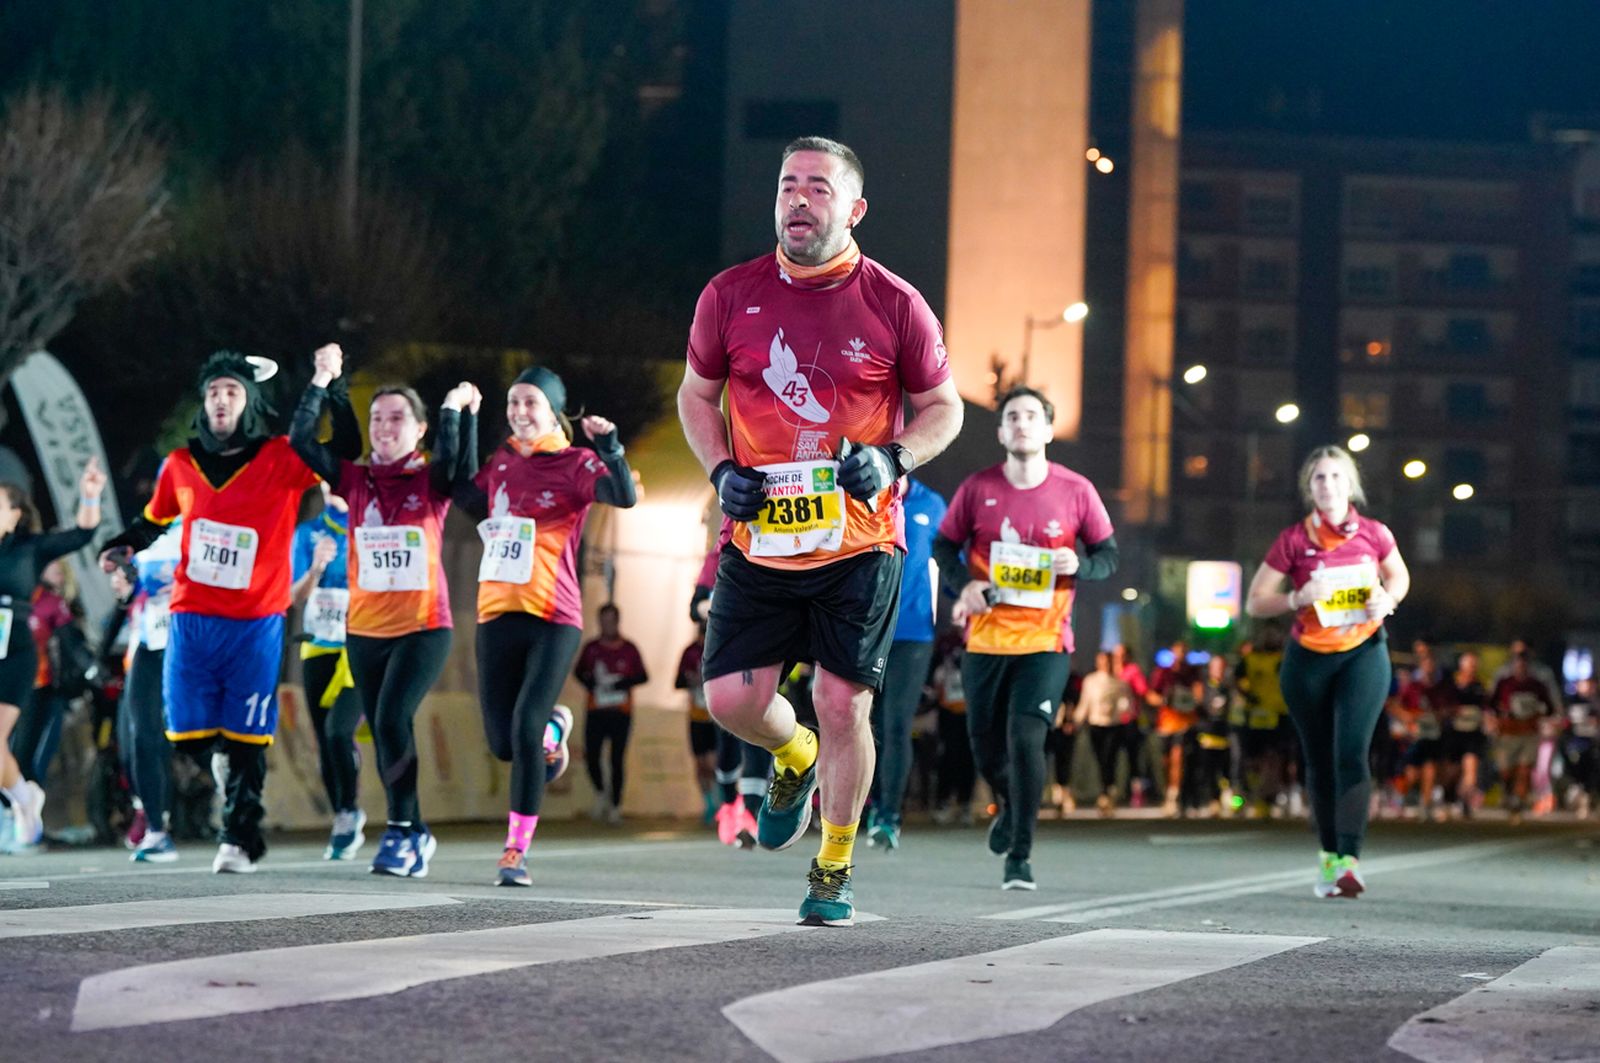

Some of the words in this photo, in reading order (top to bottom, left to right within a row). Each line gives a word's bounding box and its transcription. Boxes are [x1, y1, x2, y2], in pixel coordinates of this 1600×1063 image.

[782, 381, 808, 407] 43
[792, 472, 803, 482] DE
[771, 483, 804, 497] ANTÓN
[765, 496, 824, 525] 2381
[373, 550, 411, 568] 5157
[1001, 565, 1042, 586] 3364
[246, 692, 272, 727] 11
